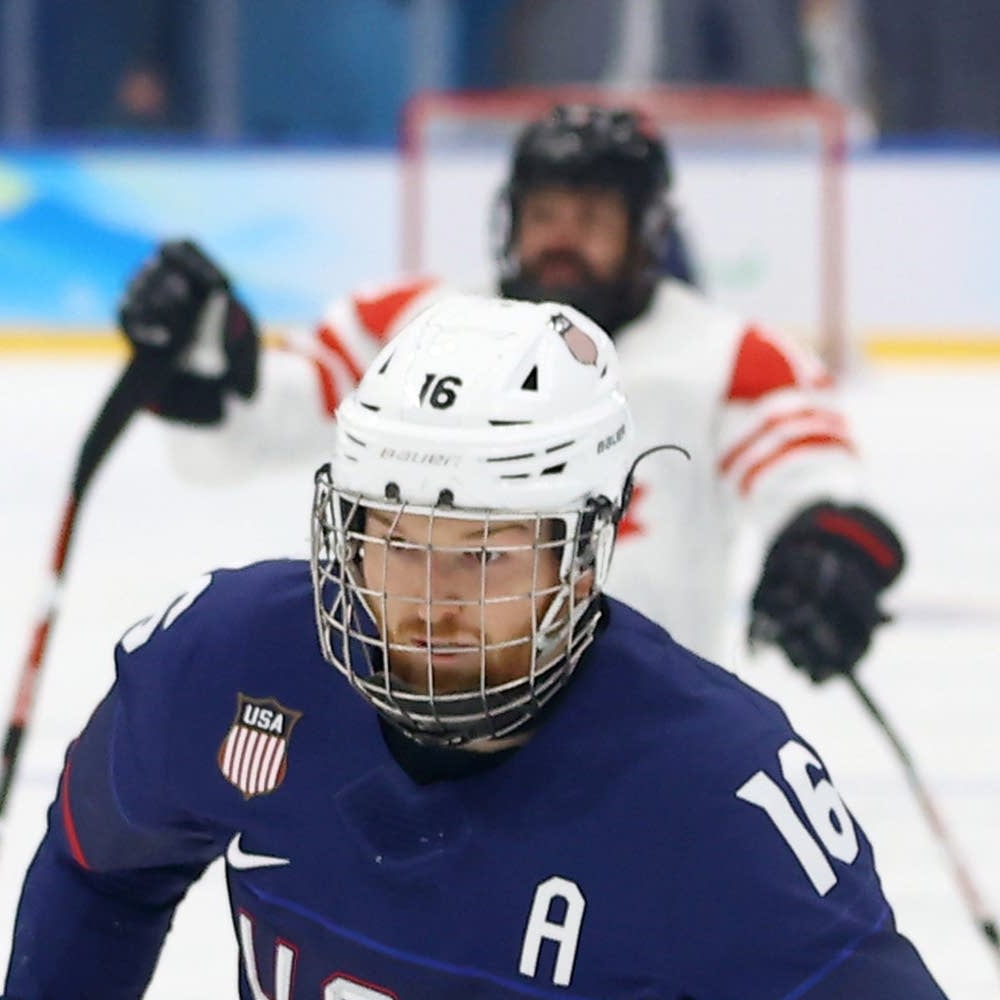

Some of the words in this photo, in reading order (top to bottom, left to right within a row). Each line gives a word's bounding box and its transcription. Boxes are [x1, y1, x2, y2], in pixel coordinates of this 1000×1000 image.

[419, 374, 462, 410] 16
[243, 704, 283, 734] USA
[735, 739, 860, 897] 16
[519, 875, 586, 987] A
